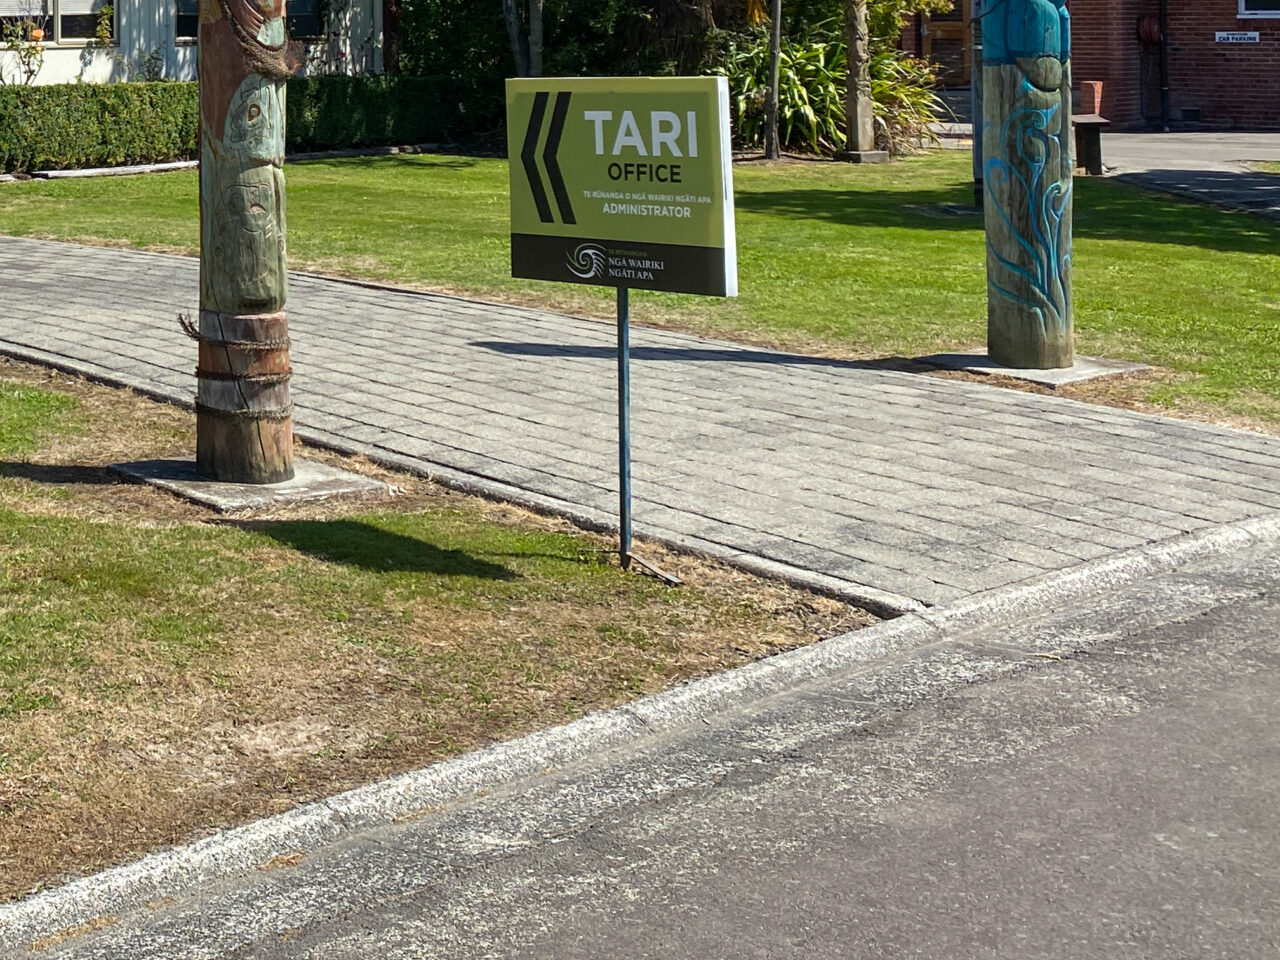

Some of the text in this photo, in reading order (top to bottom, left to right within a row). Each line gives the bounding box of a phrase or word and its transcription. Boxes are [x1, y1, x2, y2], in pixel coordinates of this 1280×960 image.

[584, 110, 698, 157] TARI
[607, 162, 682, 183] OFFICE
[583, 190, 591, 198] TE
[648, 193, 674, 202] WAIRIKI
[697, 195, 712, 204] APA
[602, 202, 692, 218] ADMINISTRATOR
[628, 258, 665, 271] WAIRIKI
[636, 270, 654, 281] APA
